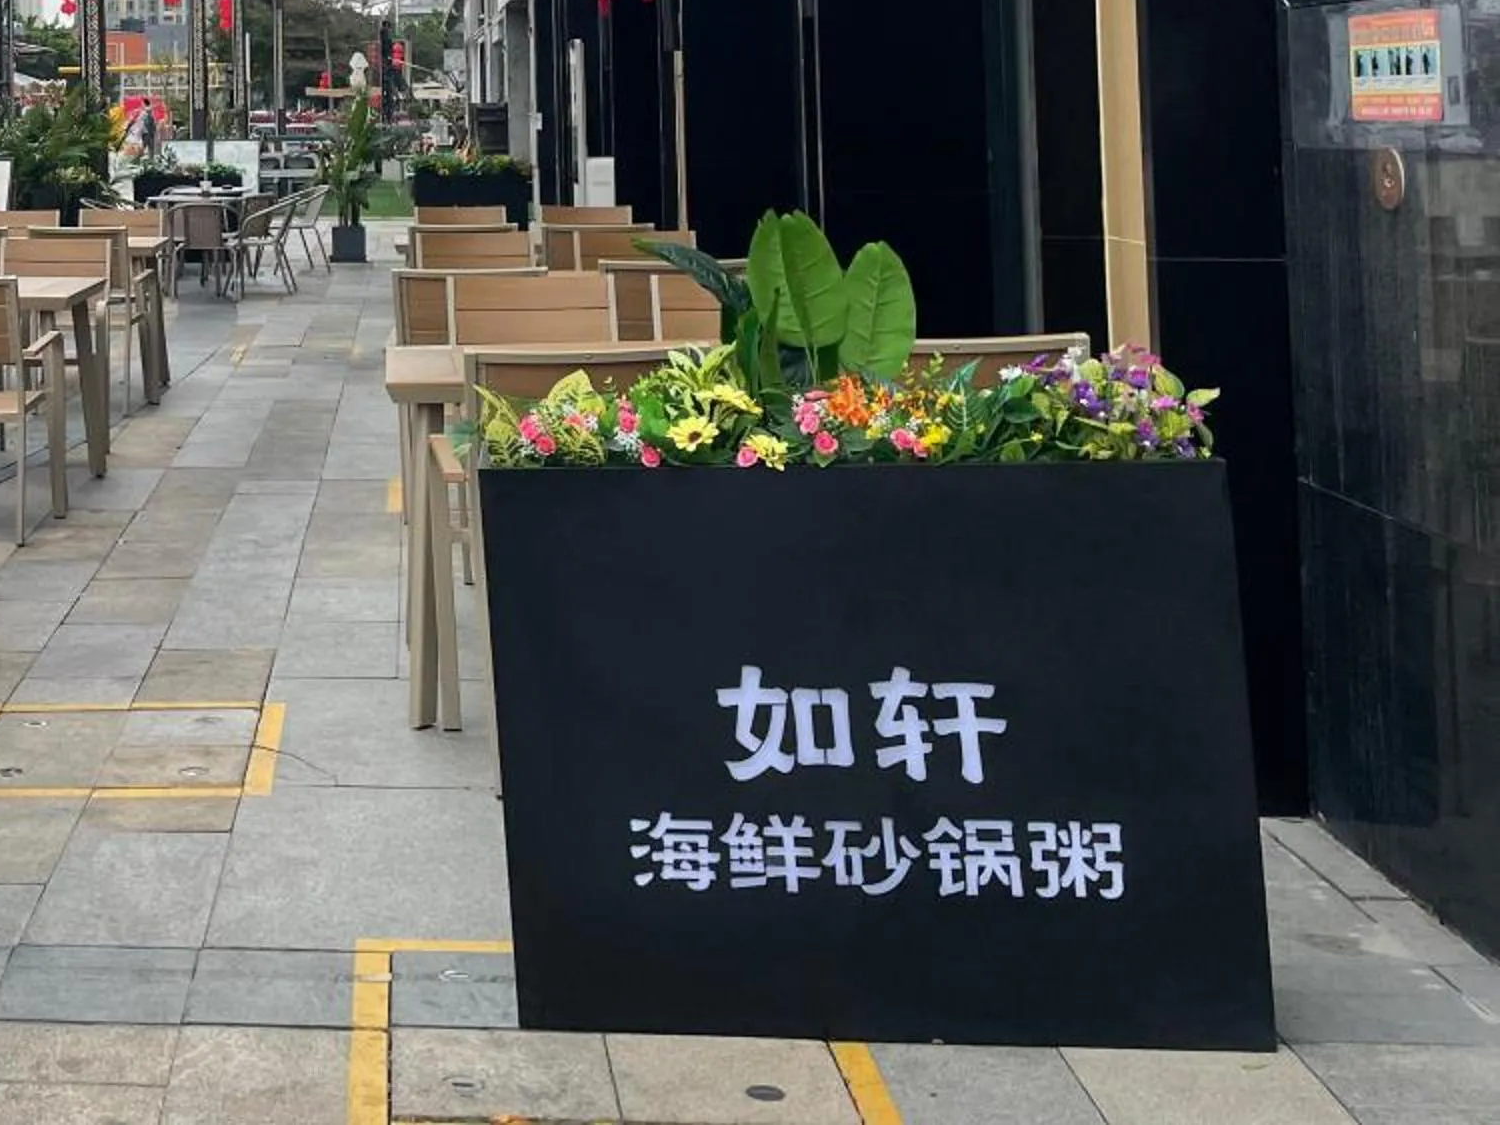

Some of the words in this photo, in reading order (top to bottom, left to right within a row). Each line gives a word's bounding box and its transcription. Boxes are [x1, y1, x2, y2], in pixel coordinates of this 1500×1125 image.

[716, 665, 1007, 784] 如轩
[629, 812, 1125, 901] 海鲜砂锅粥
